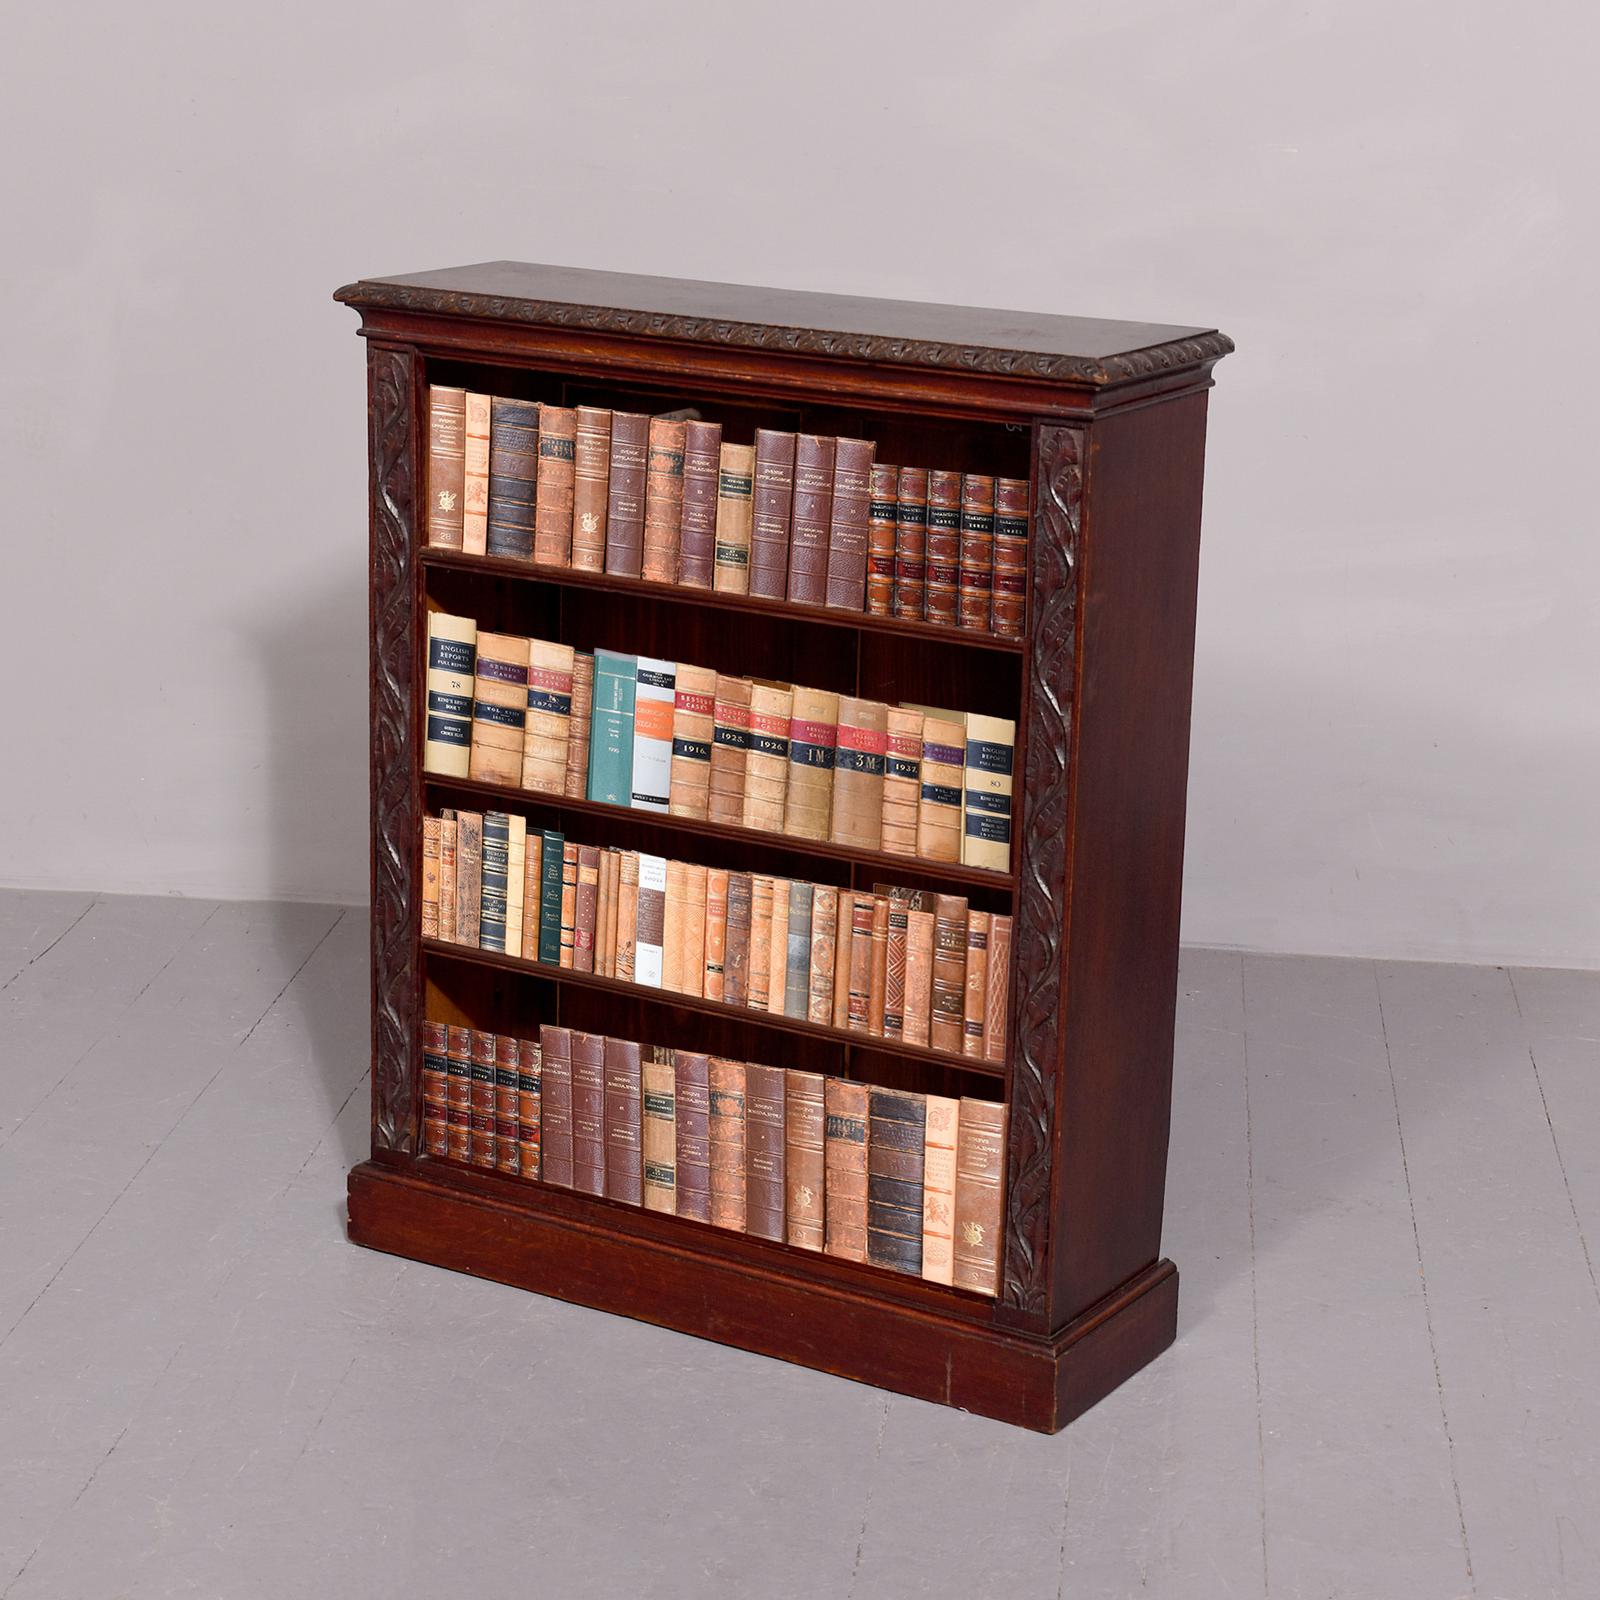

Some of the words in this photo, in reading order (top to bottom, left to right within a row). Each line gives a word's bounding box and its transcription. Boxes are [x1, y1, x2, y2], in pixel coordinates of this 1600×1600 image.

[440, 644, 470, 655] ENGLISH
[440, 651, 470, 662] REPORTS
[450, 680, 461, 688] 78
